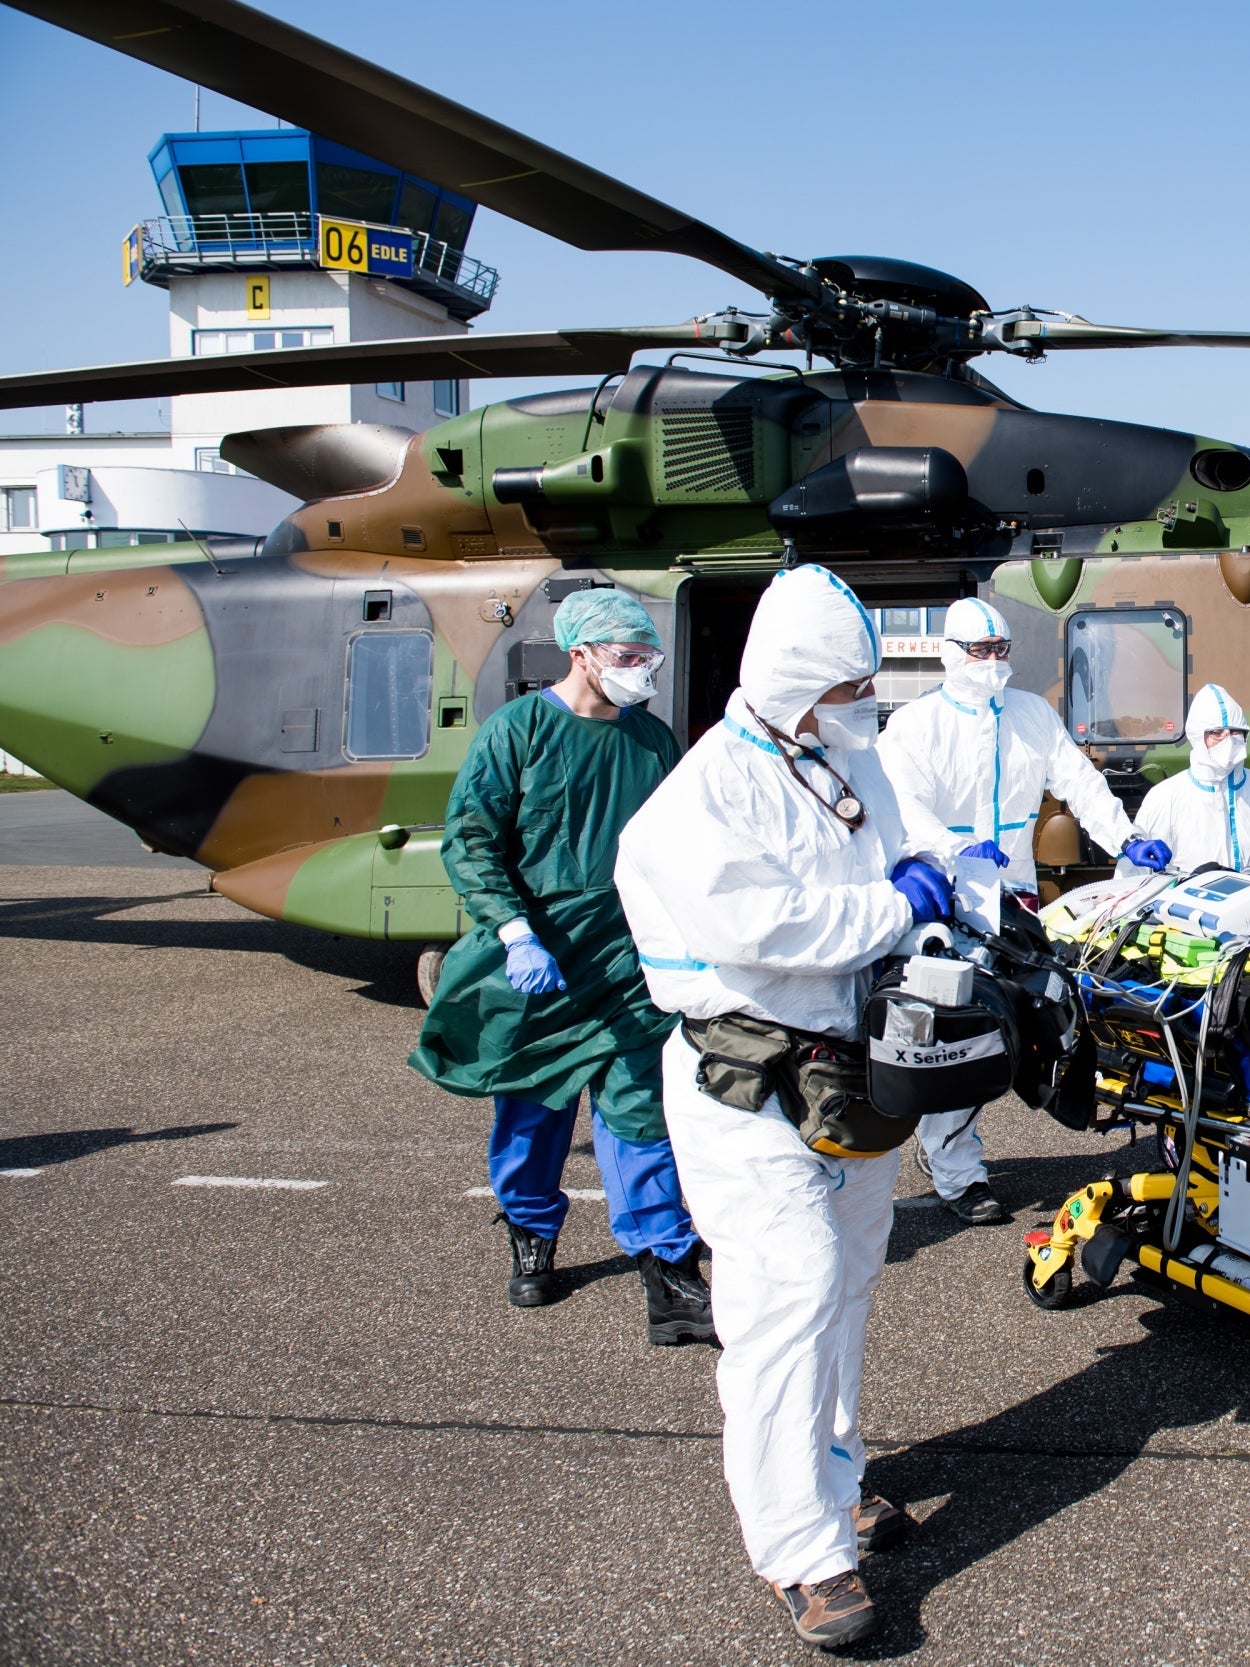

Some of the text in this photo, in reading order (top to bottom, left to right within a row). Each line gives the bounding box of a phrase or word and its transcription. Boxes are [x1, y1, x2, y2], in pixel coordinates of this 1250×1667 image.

[325, 226, 408, 264] 06 EDLE
[887, 641, 940, 653] ERWEH
[895, 1049, 908, 1063] X
